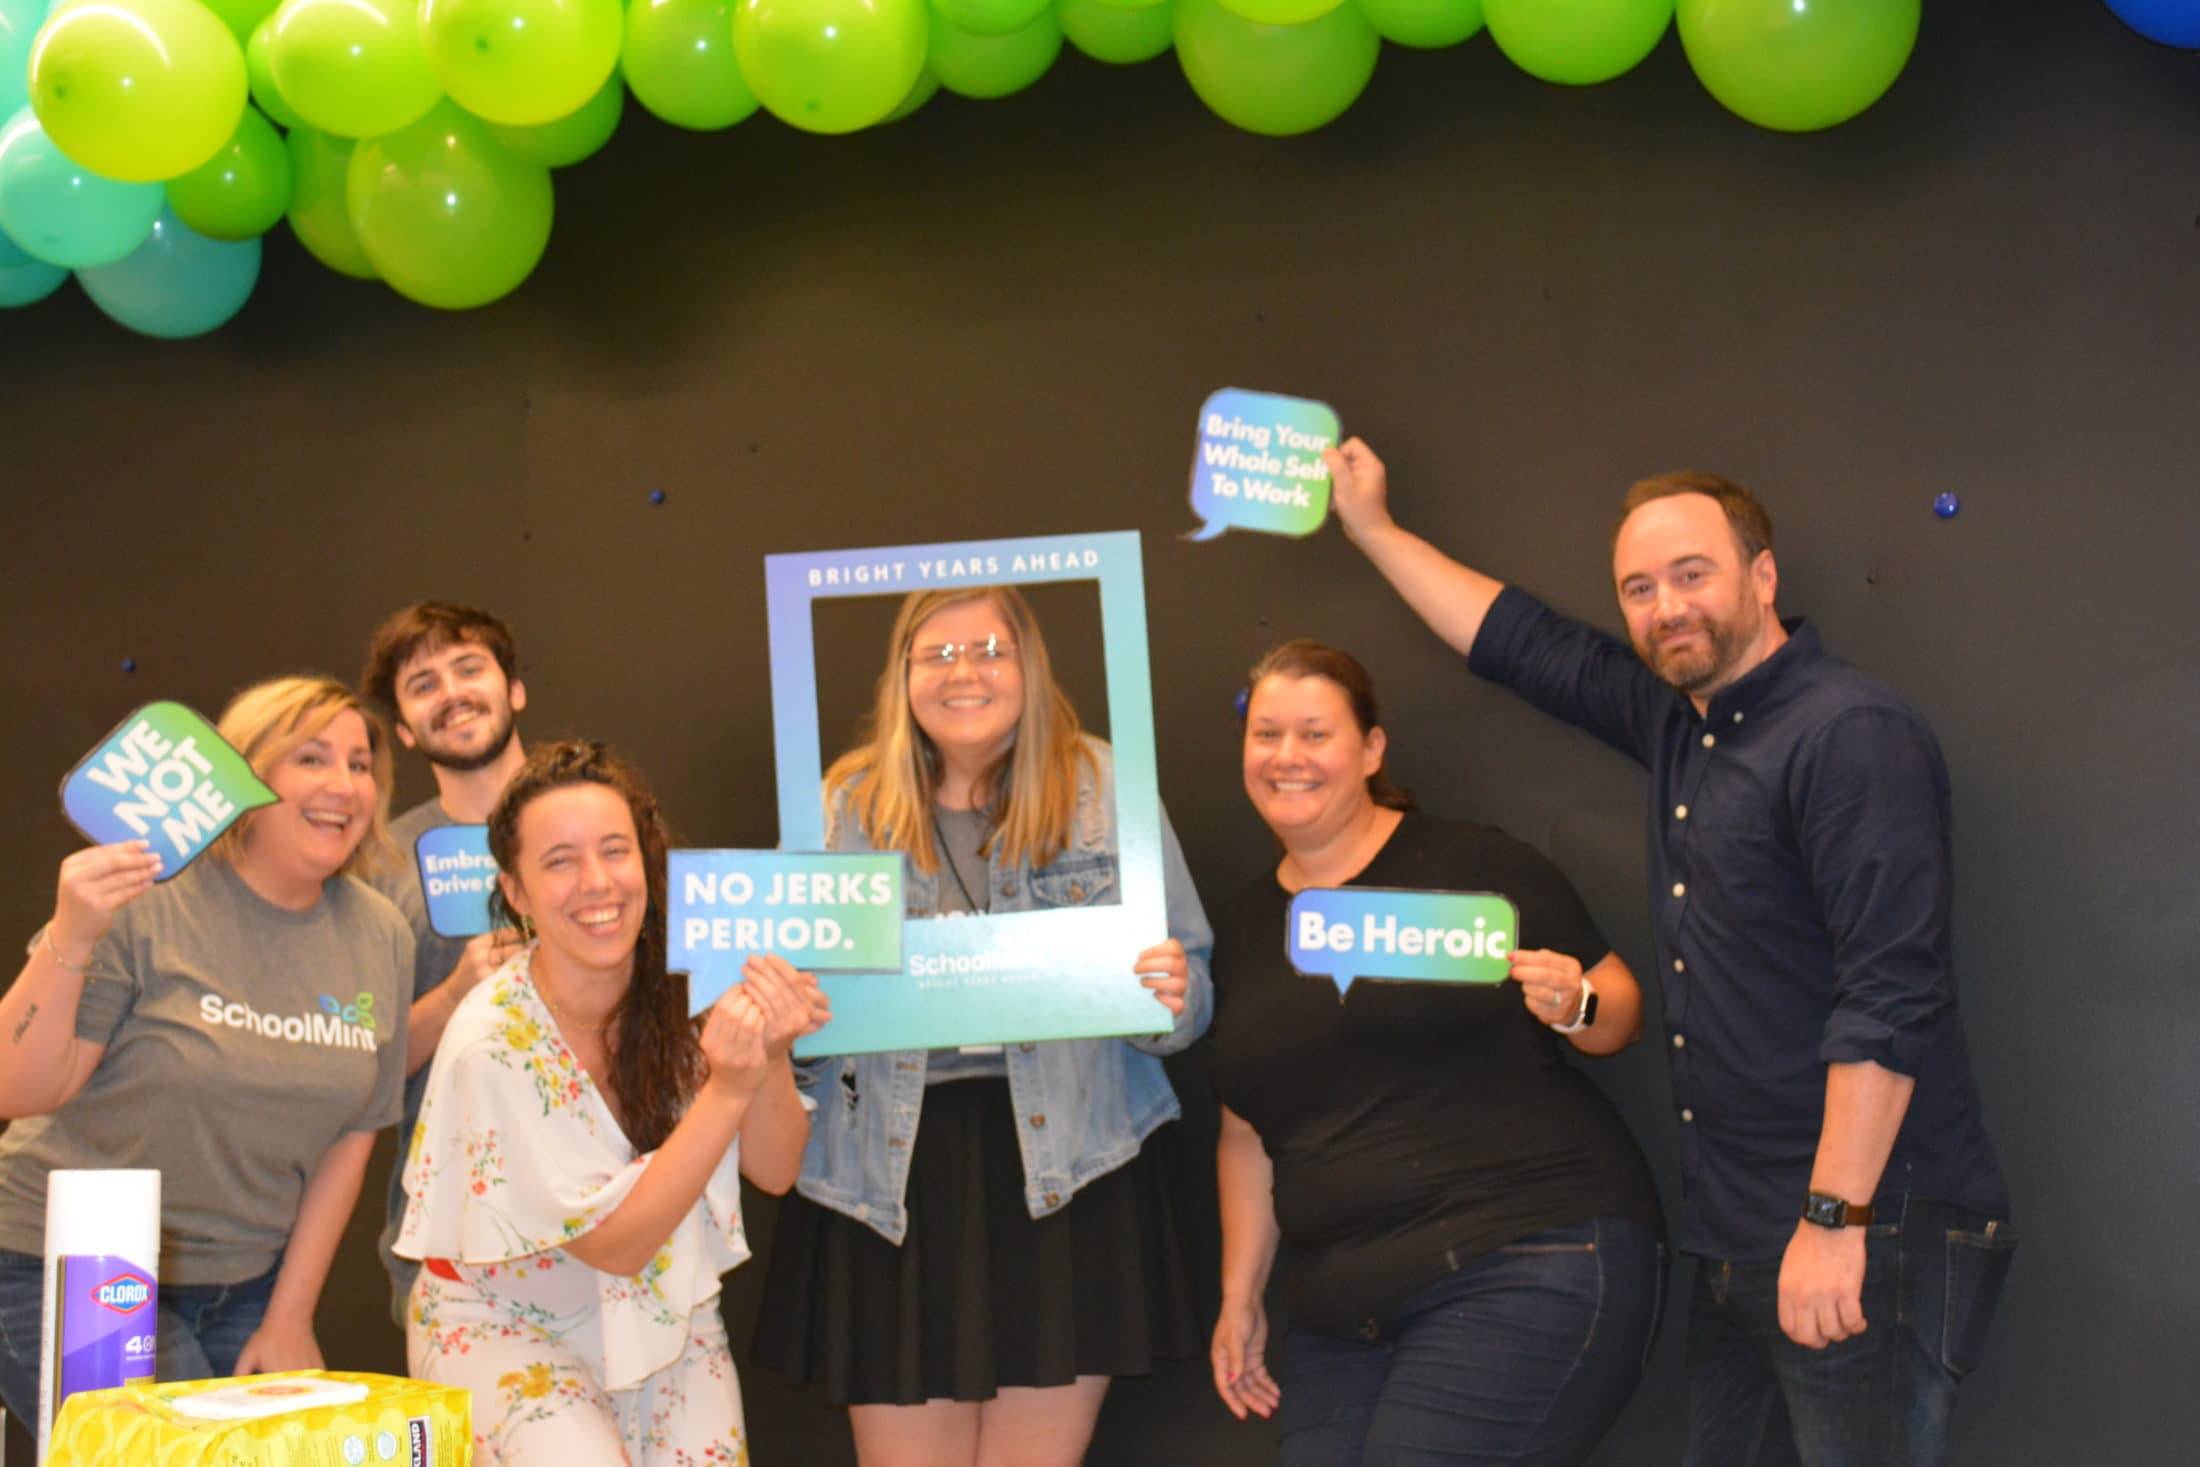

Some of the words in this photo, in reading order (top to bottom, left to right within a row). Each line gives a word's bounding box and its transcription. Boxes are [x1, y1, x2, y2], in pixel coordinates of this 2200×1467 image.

[1207, 414, 1271, 449] Bring
[1276, 424, 1331, 452] Your
[1204, 443, 1281, 476] Whole
[1212, 473, 1239, 497] To
[1242, 477, 1312, 508] Work
[808, 562, 905, 587] BRIGHT
[919, 555, 999, 579] YEARS
[1012, 549, 1099, 574] AHEAD
[86, 720, 172, 794] WE
[113, 736, 213, 836] NOT
[161, 779, 234, 858] ME
[425, 848, 498, 874] Embra
[428, 874, 482, 896] Drive
[685, 872, 754, 905] NO
[765, 872, 891, 905] JERKS
[685, 917, 854, 950] PERIOD.
[1299, 911, 1355, 952] Be
[1363, 914, 1507, 960] Heroic
[100, 1285, 148, 1304] CLOROX
